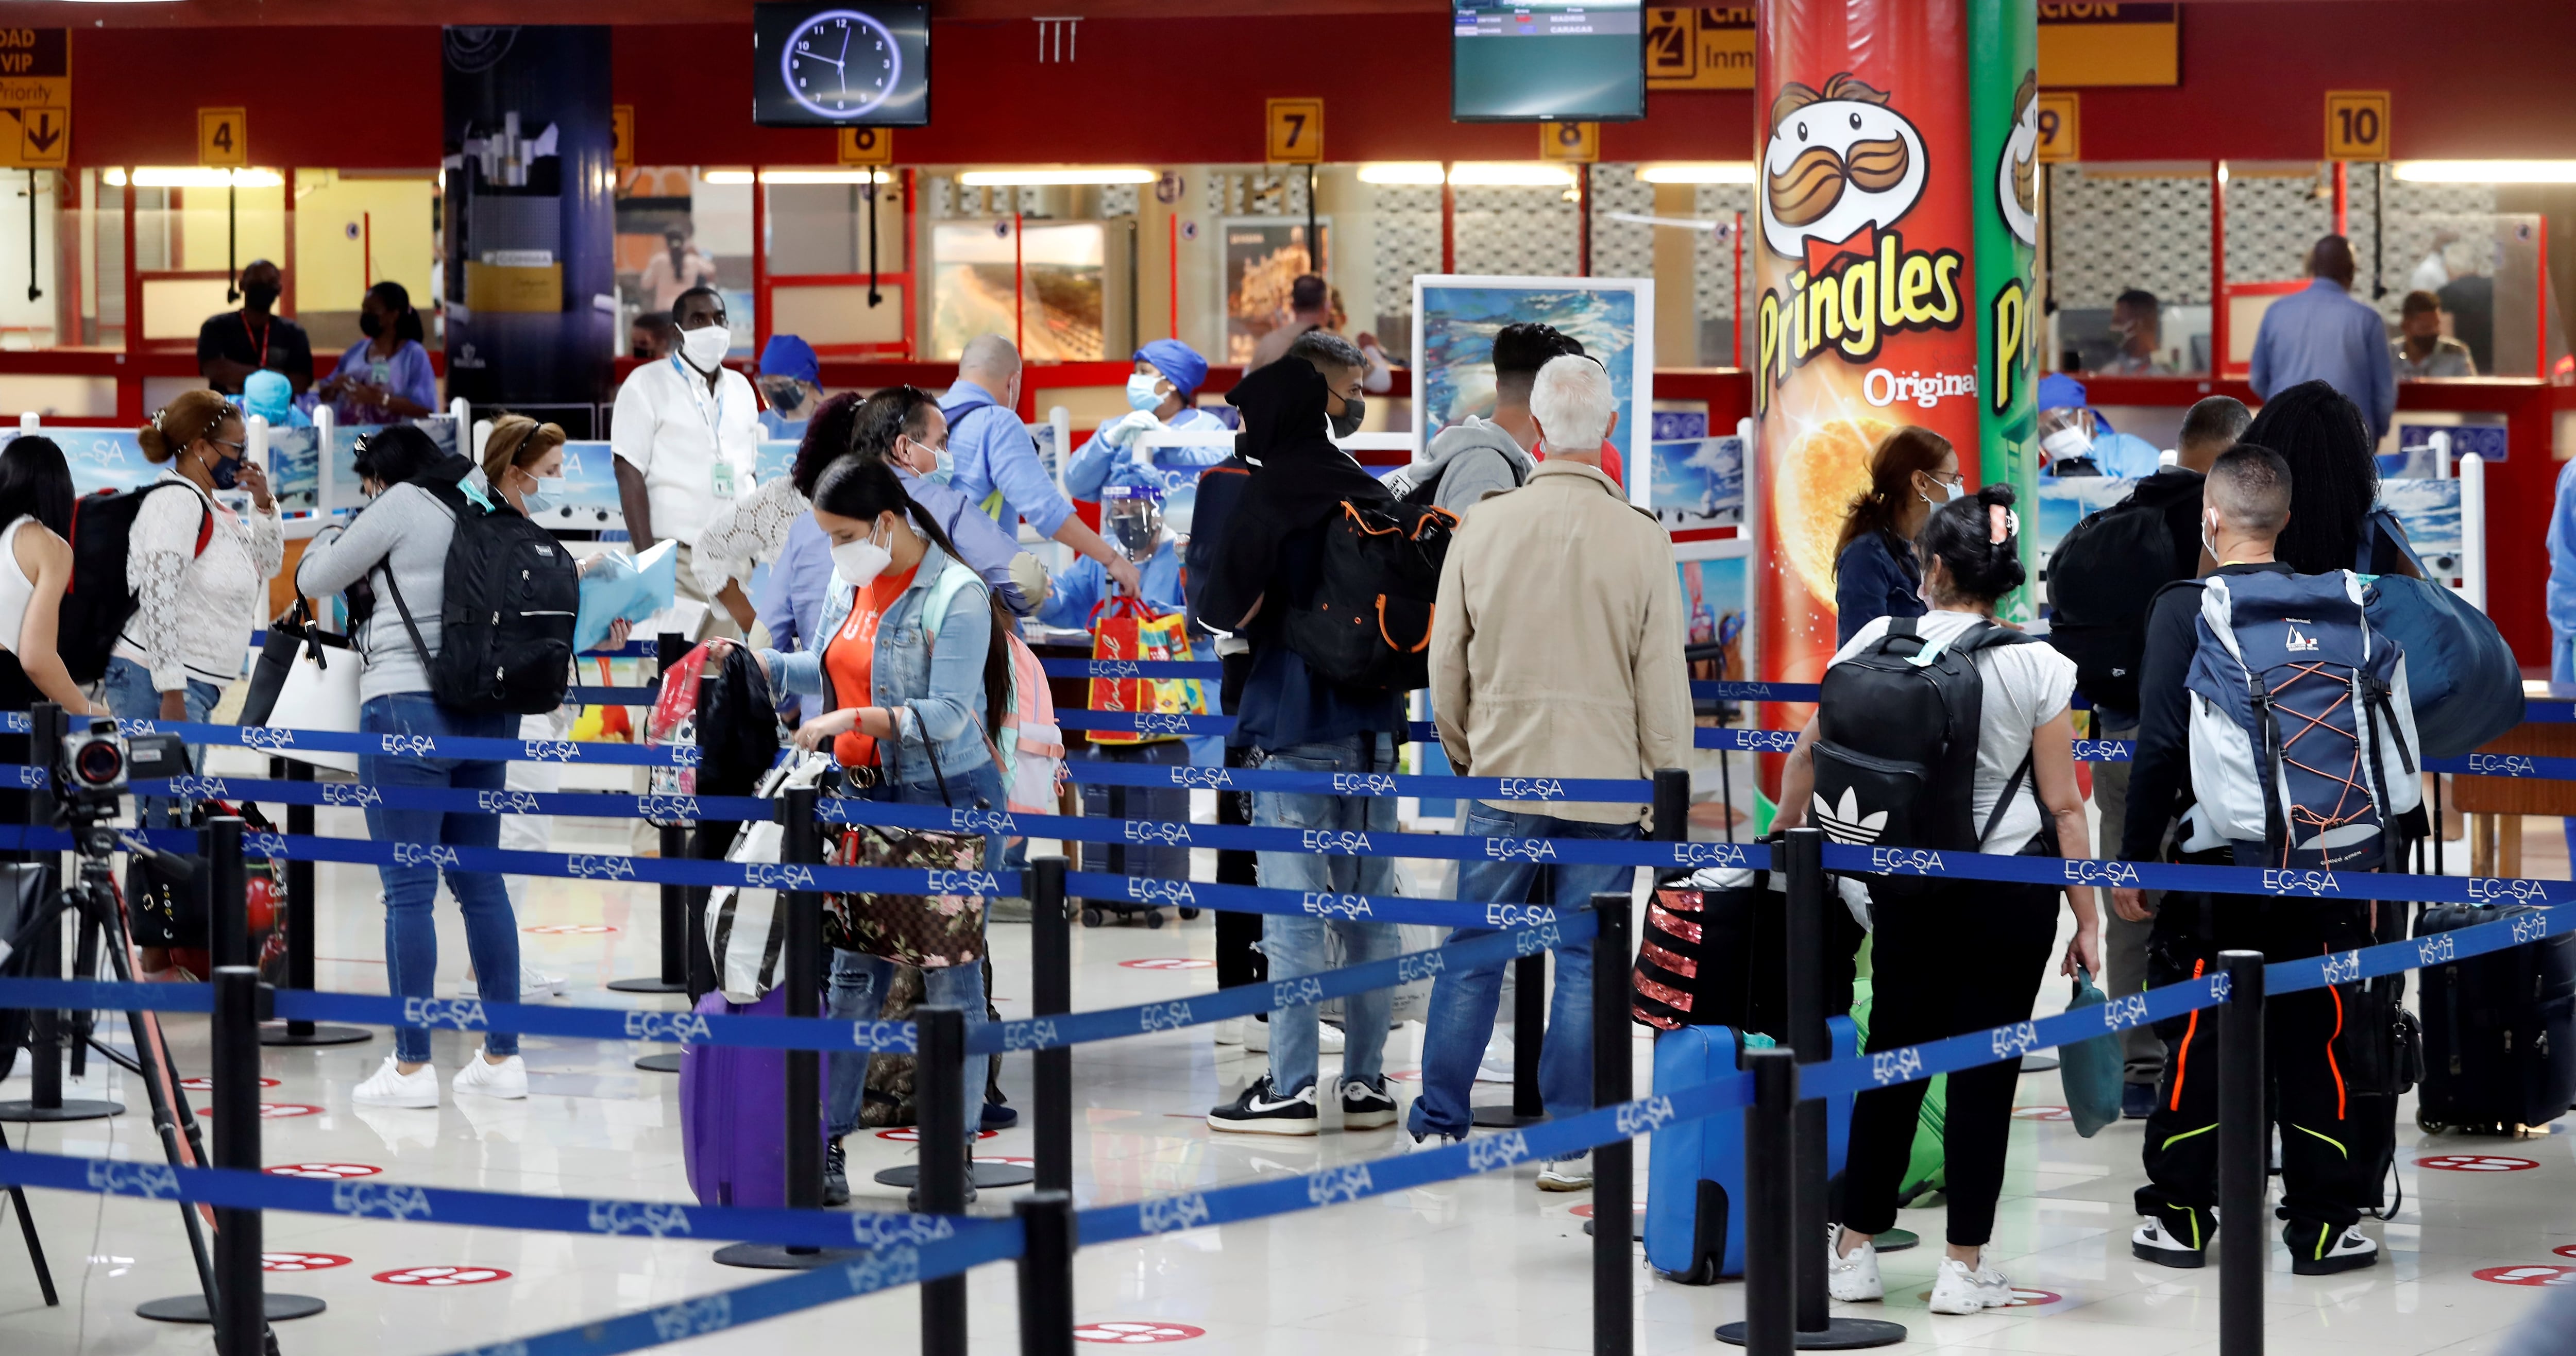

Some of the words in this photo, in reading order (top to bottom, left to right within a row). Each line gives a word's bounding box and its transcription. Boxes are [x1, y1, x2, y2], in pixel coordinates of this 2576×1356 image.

[836, 19, 848, 28] 12
[814, 25, 824, 35] 11
[862, 25, 867, 35] 1
[799, 41, 809, 50] 10
[876, 41, 883, 50] 2
[1705, 43, 1754, 69] Inm
[1, 53, 33, 72] VIP
[792, 59, 799, 69] 9
[883, 59, 890, 69] 3
[800, 77, 807, 88] 8
[876, 77, 882, 87] 4
[816, 93, 821, 103] 7
[2038, 109, 2060, 146] 9
[2336, 108, 2379, 144] 10
[1283, 114, 1307, 149] 7
[213, 122, 232, 154] 4
[1759, 233, 1961, 416] Pringles
